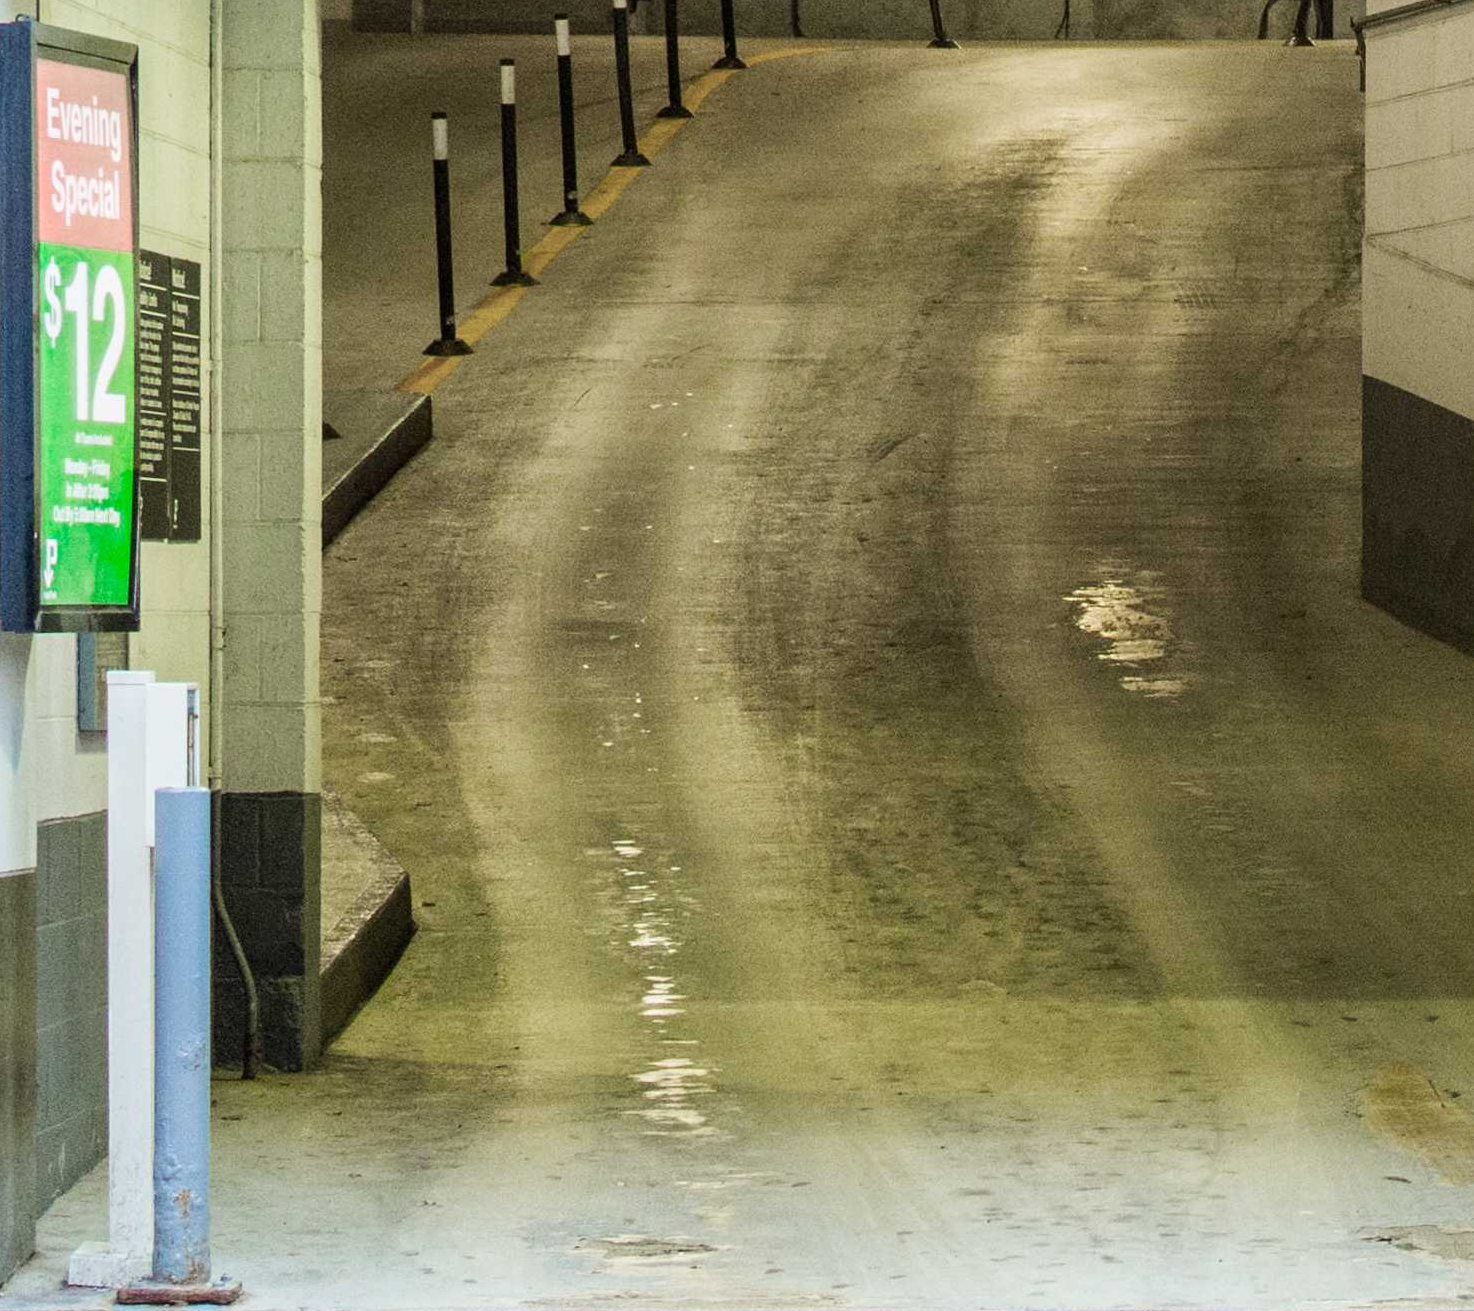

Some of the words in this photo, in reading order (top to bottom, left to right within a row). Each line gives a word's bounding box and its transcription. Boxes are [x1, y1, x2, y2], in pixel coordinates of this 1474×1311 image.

[46, 87, 122, 162] Evening
[51, 160, 121, 227] Special
[44, 256, 127, 423] $12
